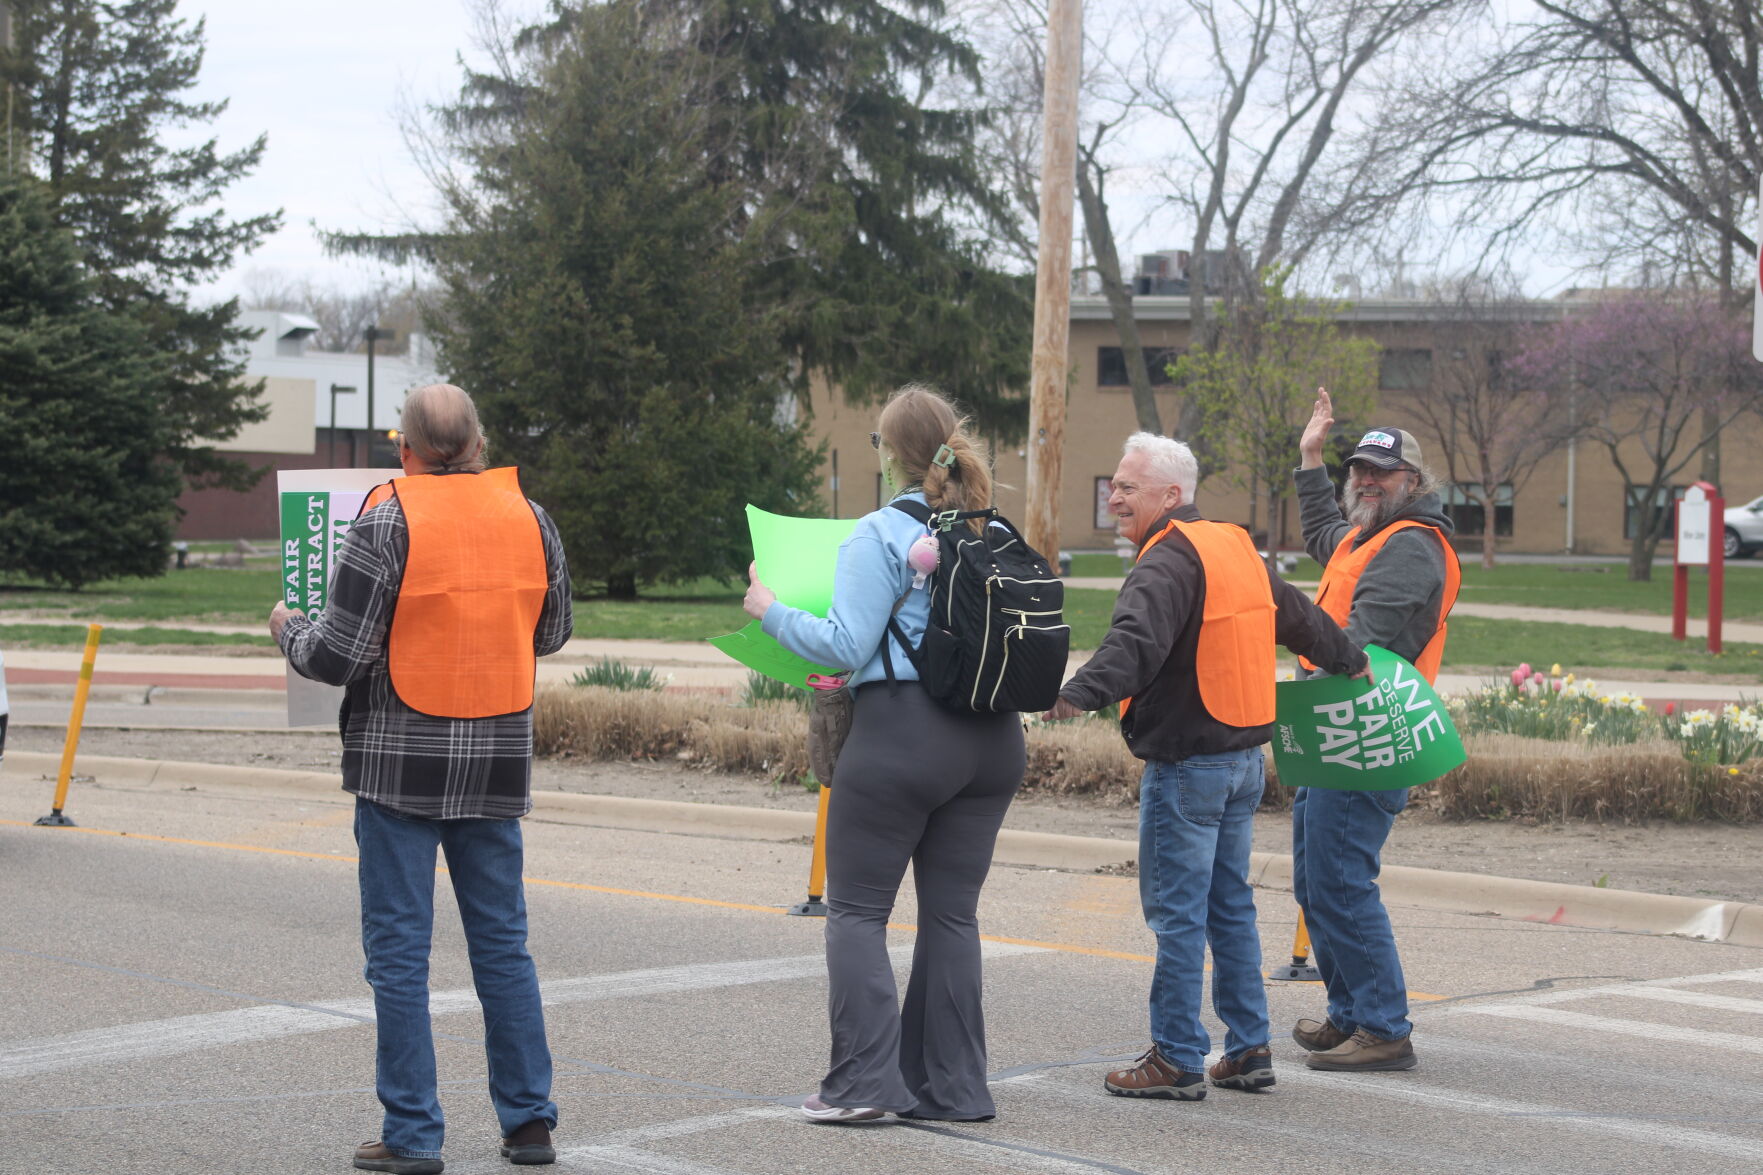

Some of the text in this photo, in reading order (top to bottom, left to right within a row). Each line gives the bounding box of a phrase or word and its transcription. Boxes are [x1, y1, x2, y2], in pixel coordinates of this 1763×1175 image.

[285, 537, 300, 604] FAIR
[307, 495, 324, 626] ONTRACT
[1313, 699, 1363, 771] PAY
[1355, 686, 1396, 770] FAIR
[1379, 678, 1415, 764] DESERVE
[1392, 661, 1447, 752] WE
